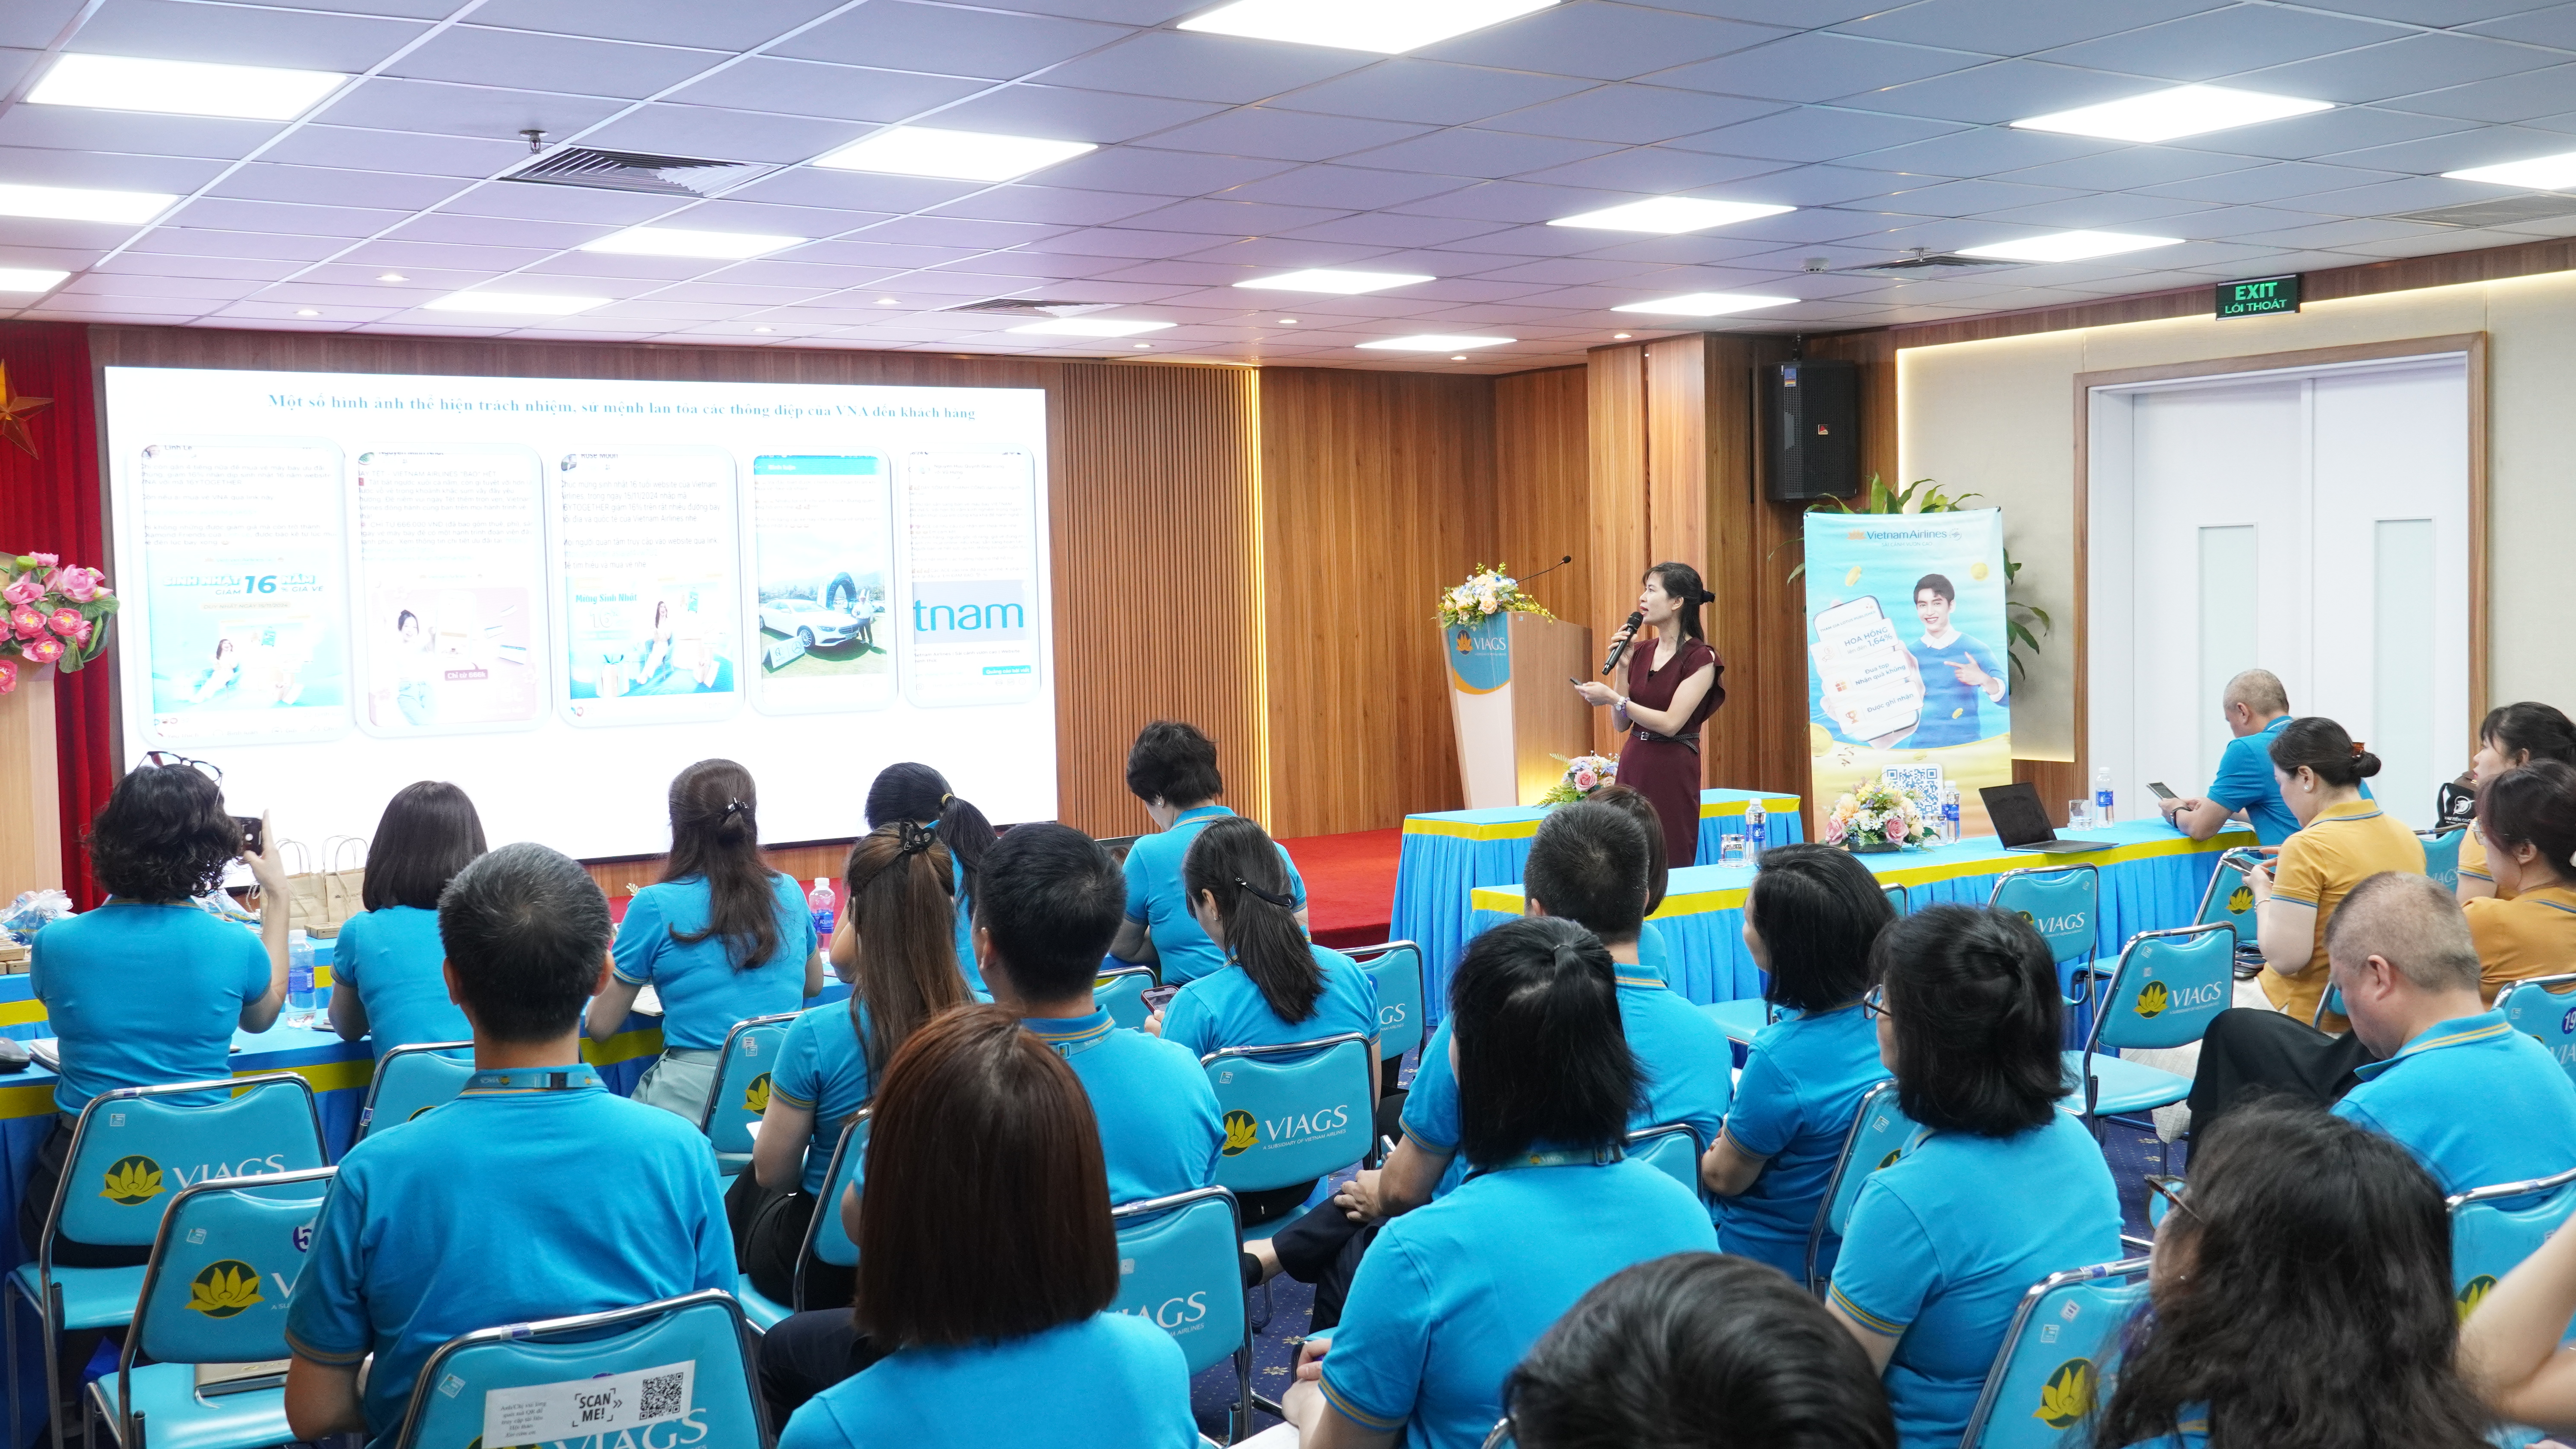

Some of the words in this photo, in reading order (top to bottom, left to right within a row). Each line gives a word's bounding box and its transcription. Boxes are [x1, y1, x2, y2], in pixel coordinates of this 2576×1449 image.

[2235, 282, 2278, 301] EXIT
[2246, 299, 2287, 311] THOÁT
[269, 395, 302, 410] Một
[441, 399, 472, 413] hiện
[479, 400, 519, 411] trách
[605, 402, 643, 415] mệnh
[650, 403, 670, 413] lan
[703, 404, 725, 414] các
[730, 404, 769, 417] thông
[775, 405, 803, 418] điệp
[836, 406, 868, 416] VNA
[901, 407, 939, 417] khách
[945, 408, 975, 420] hàng
[1866, 531, 1908, 540] Vietnam
[1909, 530, 1947, 539] Airlines
[163, 576, 198, 586] SINH
[201, 574, 241, 587] NHẬT
[245, 576, 276, 593] 16
[282, 573, 316, 585] NĂM
[914, 600, 1024, 632] tnam
[1853, 610, 1876, 620] PUBLISHER
[1473, 637, 1506, 650] VIAGS
[1844, 636, 1862, 646] HOA
[1868, 634, 1893, 647] 1,64%
[1856, 677, 1872, 685] Nhận
[1873, 672, 1885, 680] quà
[1886, 665, 1906, 675] khủng
[1867, 703, 1884, 712] Được
[1886, 698, 1896, 707] ghi
[1897, 694, 1914, 702] nhận
[2038, 912, 2085, 933] VIAGS
[2172, 981, 2222, 1007] VIAGS
[2564, 1011, 2576, 1031] 19
[1265, 1105, 1348, 1141] VIAGS
[1268, 1140, 1296, 1150] SUBSIDIARY
[1305, 1134, 1325, 1143] VIETNAM
[1326, 1129, 1346, 1137] AIRLINES
[1177, 1323, 1204, 1335] AIRLINES
[579, 1393, 611, 1409] SCAN
[582, 1407, 605, 1422] ME!
